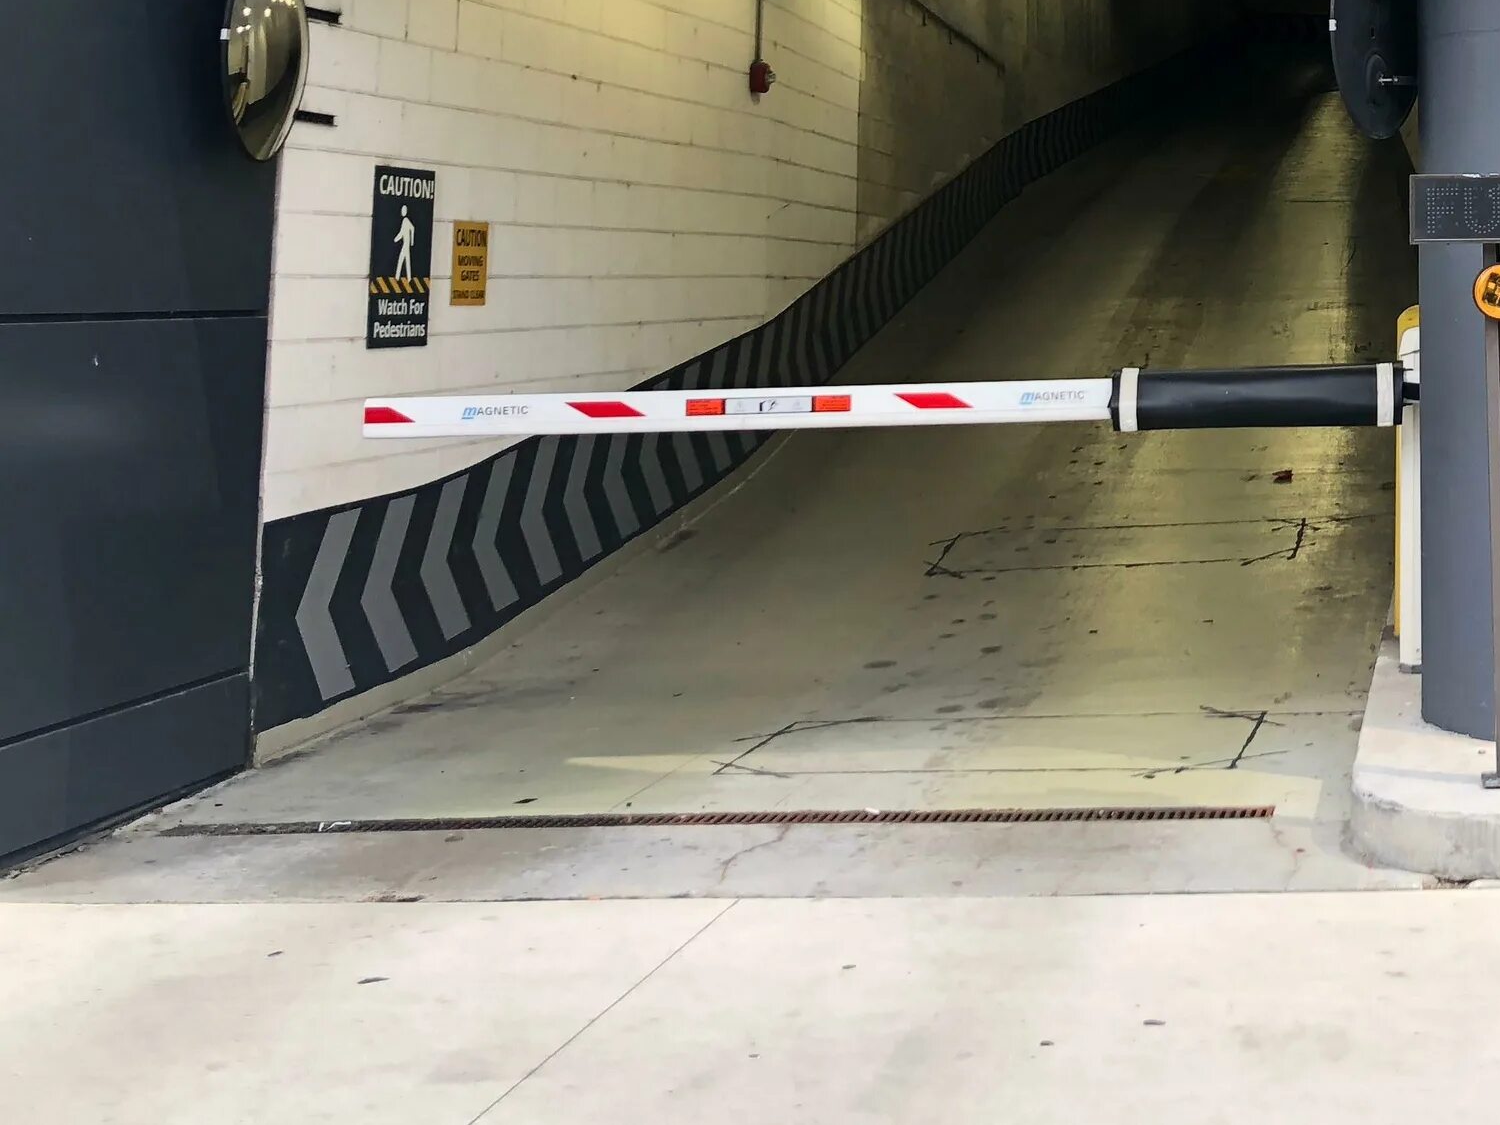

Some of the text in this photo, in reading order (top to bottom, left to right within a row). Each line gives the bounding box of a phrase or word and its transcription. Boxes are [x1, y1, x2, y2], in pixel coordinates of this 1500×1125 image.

[379, 174, 434, 200] CAUTION!
[456, 228, 487, 247] CAUTION
[378, 298, 425, 315] Watch For
[373, 321, 426, 339] Pedestrians
